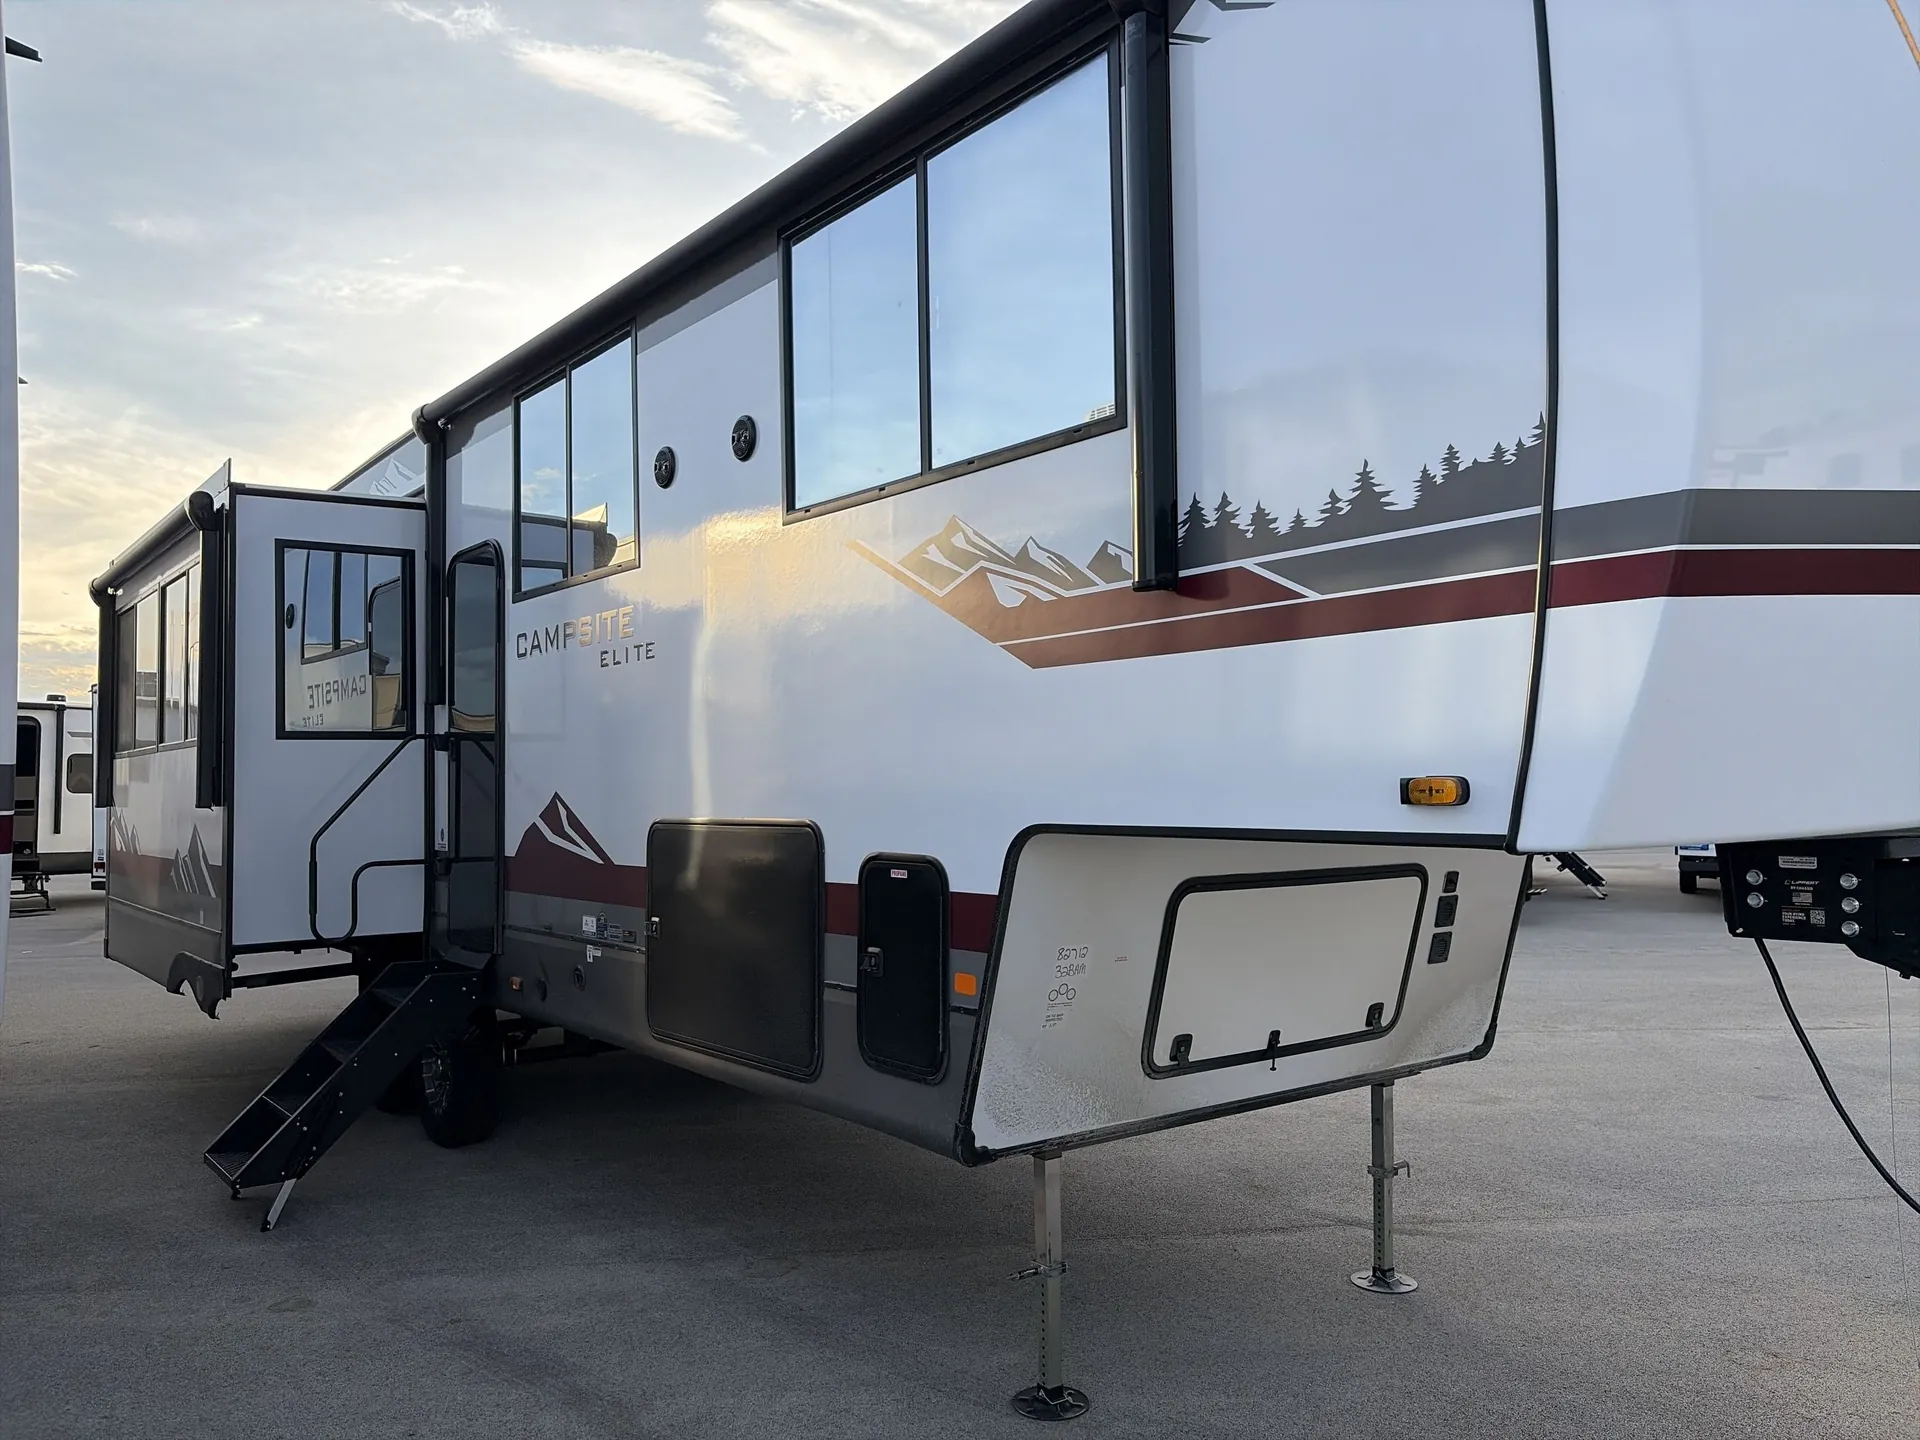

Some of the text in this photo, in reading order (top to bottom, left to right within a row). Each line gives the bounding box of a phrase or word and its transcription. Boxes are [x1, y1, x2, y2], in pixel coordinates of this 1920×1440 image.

[516, 605, 634, 660] CAMPSITE
[600, 641, 655, 668] ELITE
[1057, 946, 1088, 961] 82712
